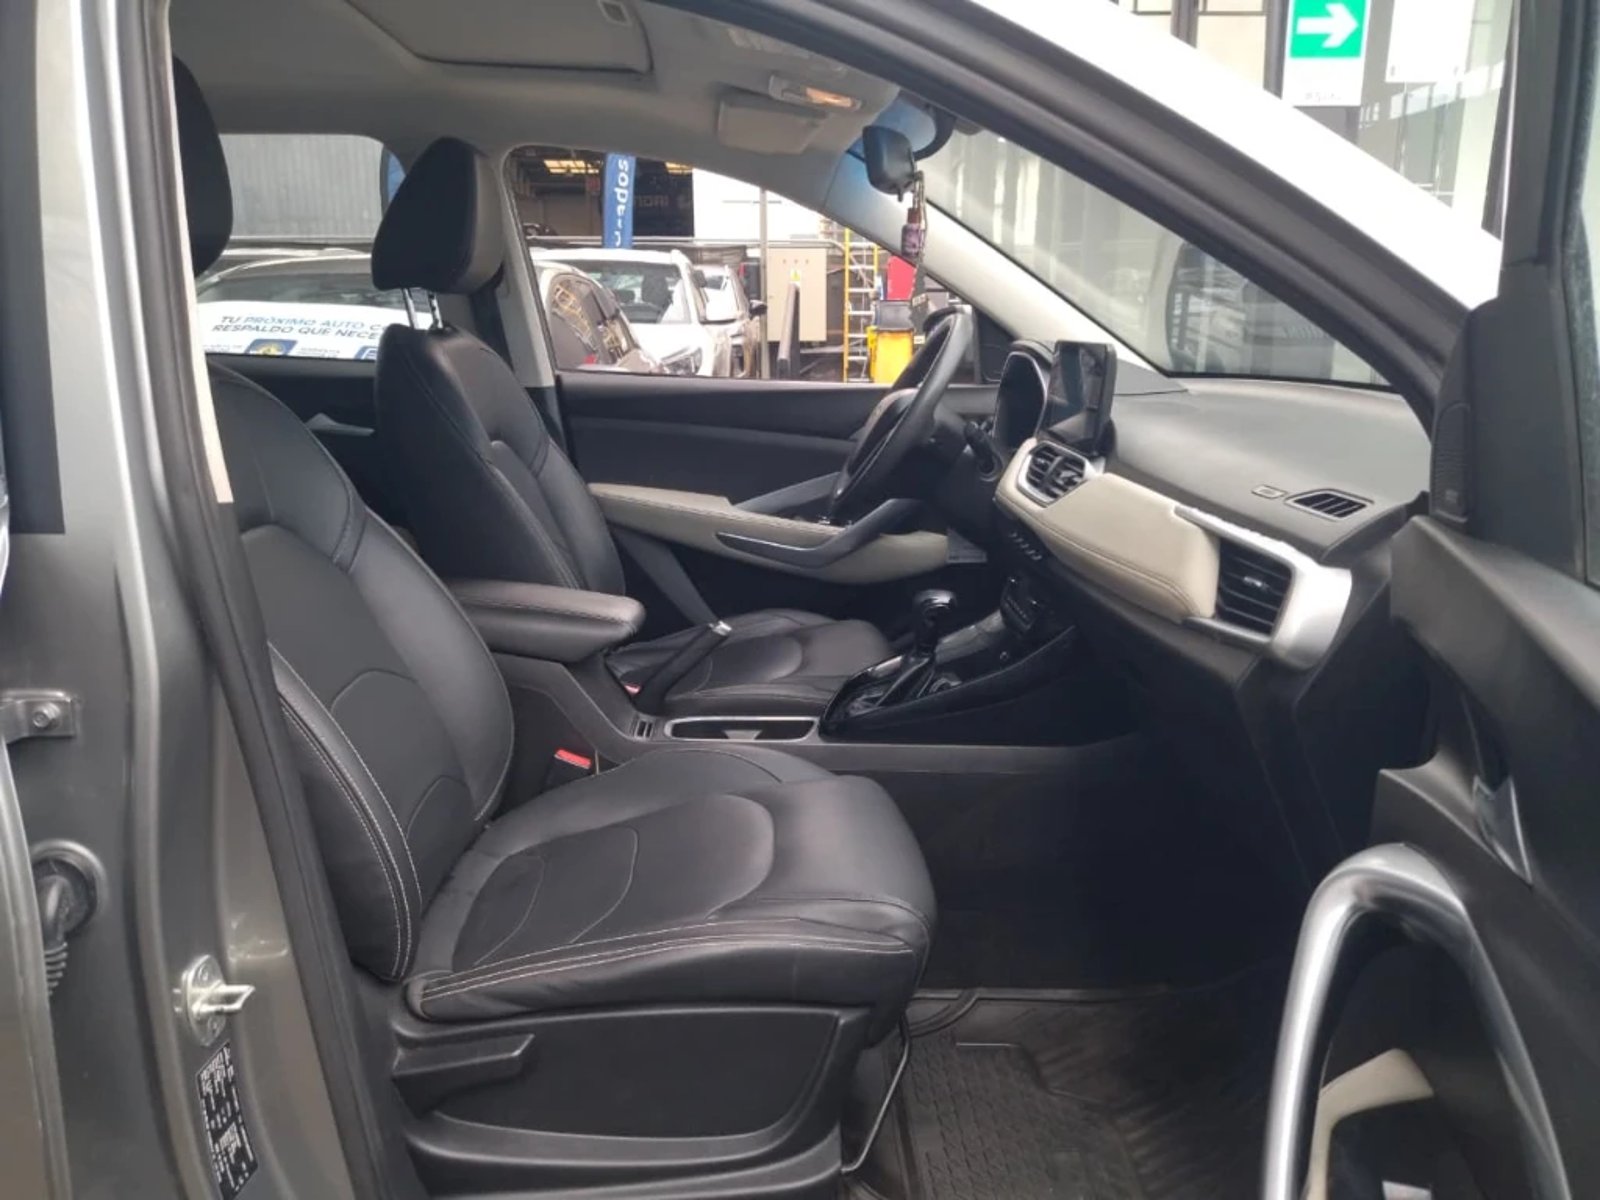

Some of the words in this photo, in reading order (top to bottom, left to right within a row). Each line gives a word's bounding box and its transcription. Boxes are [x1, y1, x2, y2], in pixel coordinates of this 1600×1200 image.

[220, 315, 241, 324] TU
[320, 319, 365, 329] AUTO
[211, 324, 294, 334] RESPALDO
[298, 327, 333, 336] QUE
